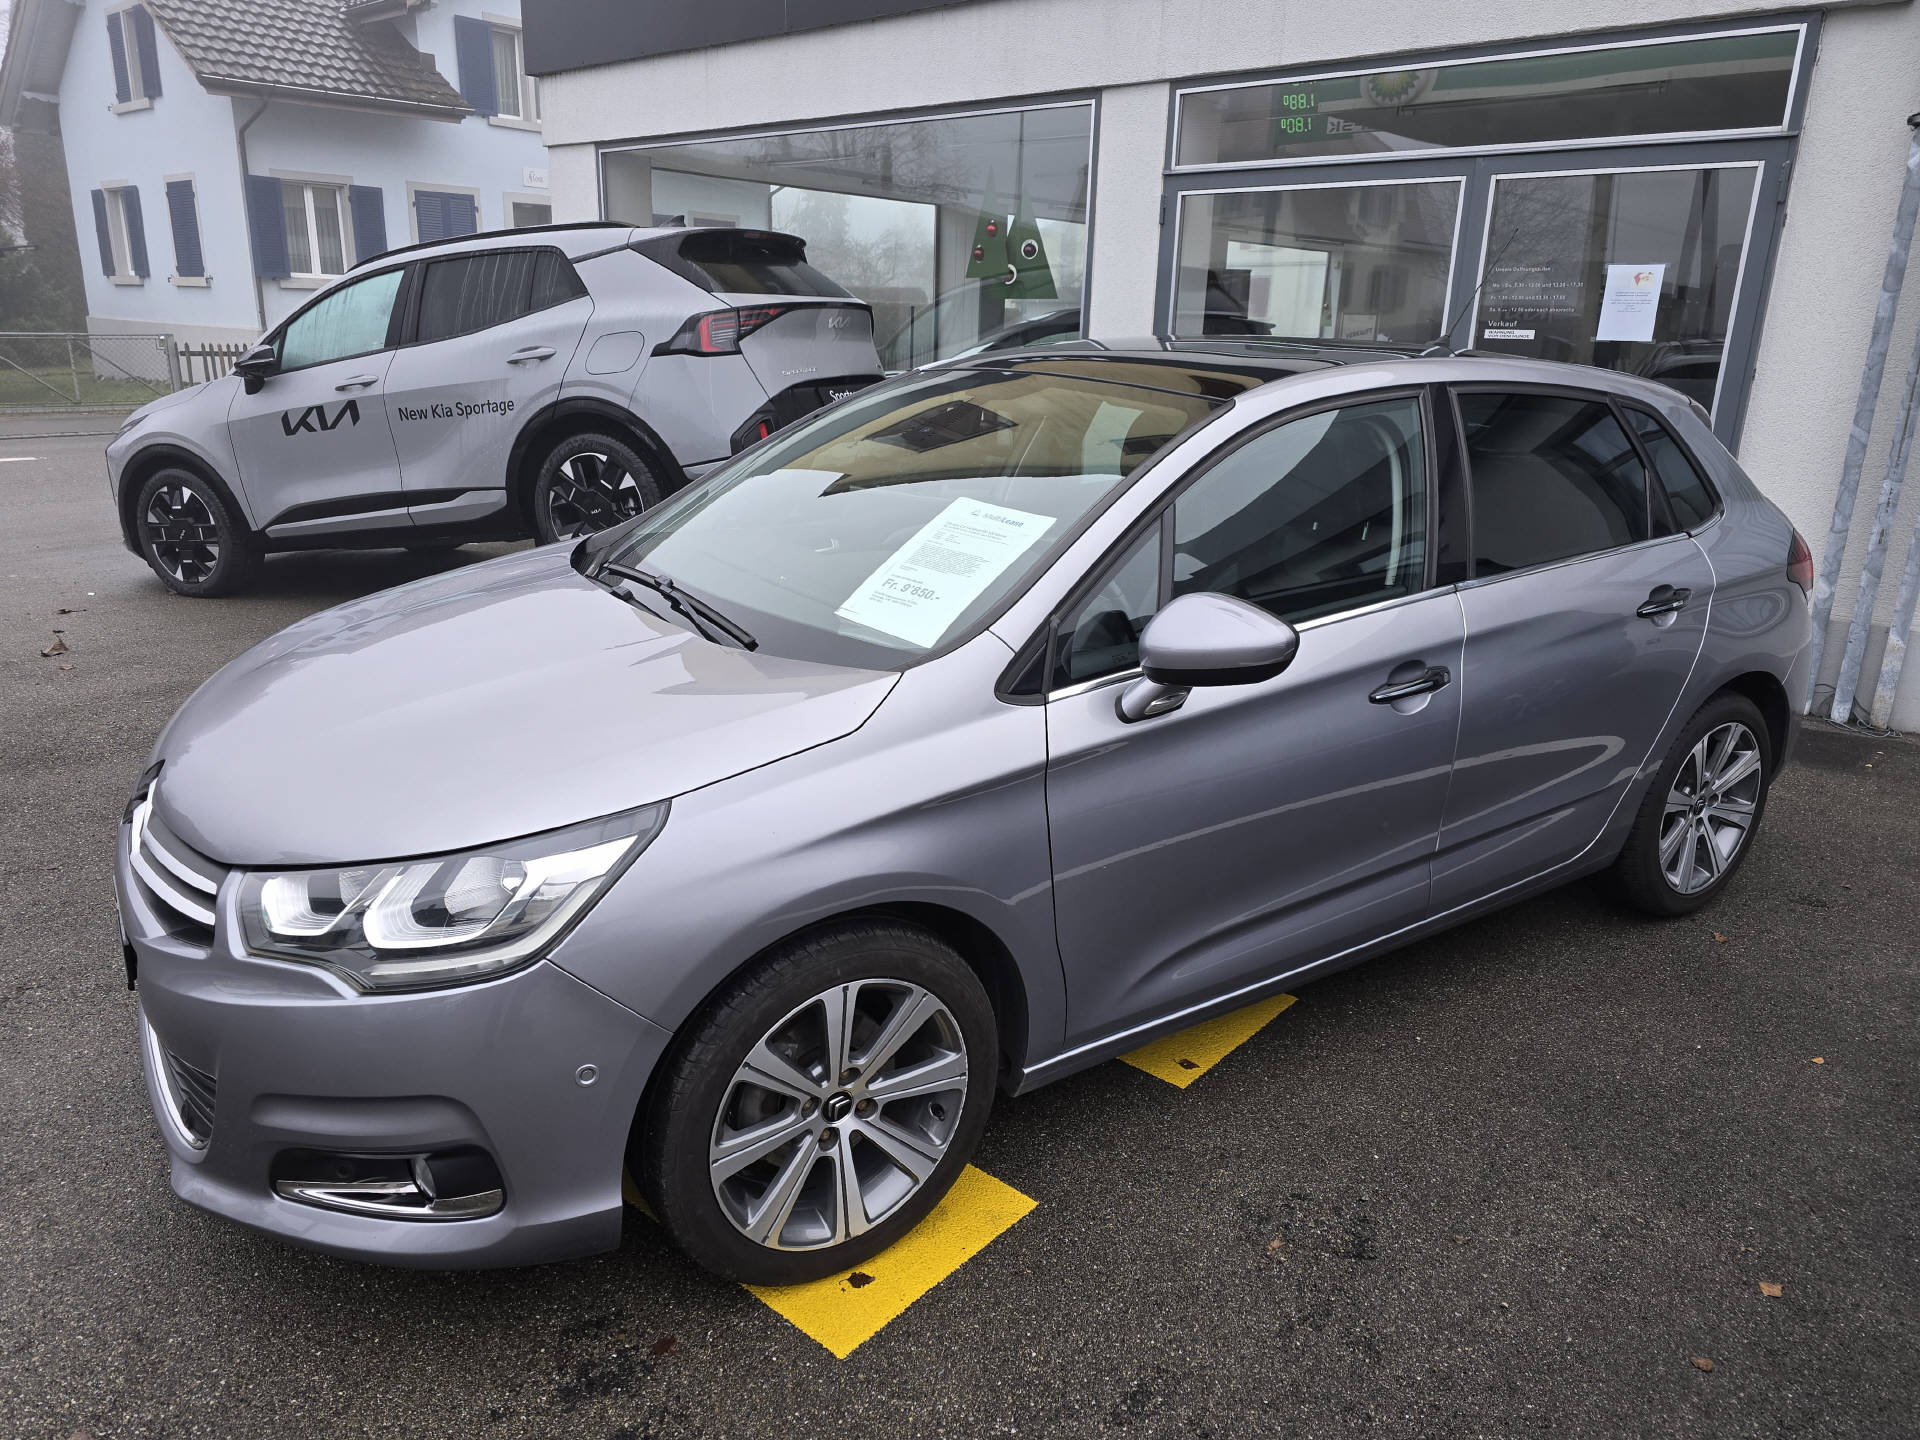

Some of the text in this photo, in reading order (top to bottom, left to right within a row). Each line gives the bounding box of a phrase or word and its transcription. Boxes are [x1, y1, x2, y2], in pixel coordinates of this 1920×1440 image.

[281, 400, 361, 437] KIA
[398, 400, 515, 422] New Kia Sportage
[882, 578, 899, 590] Fr.
